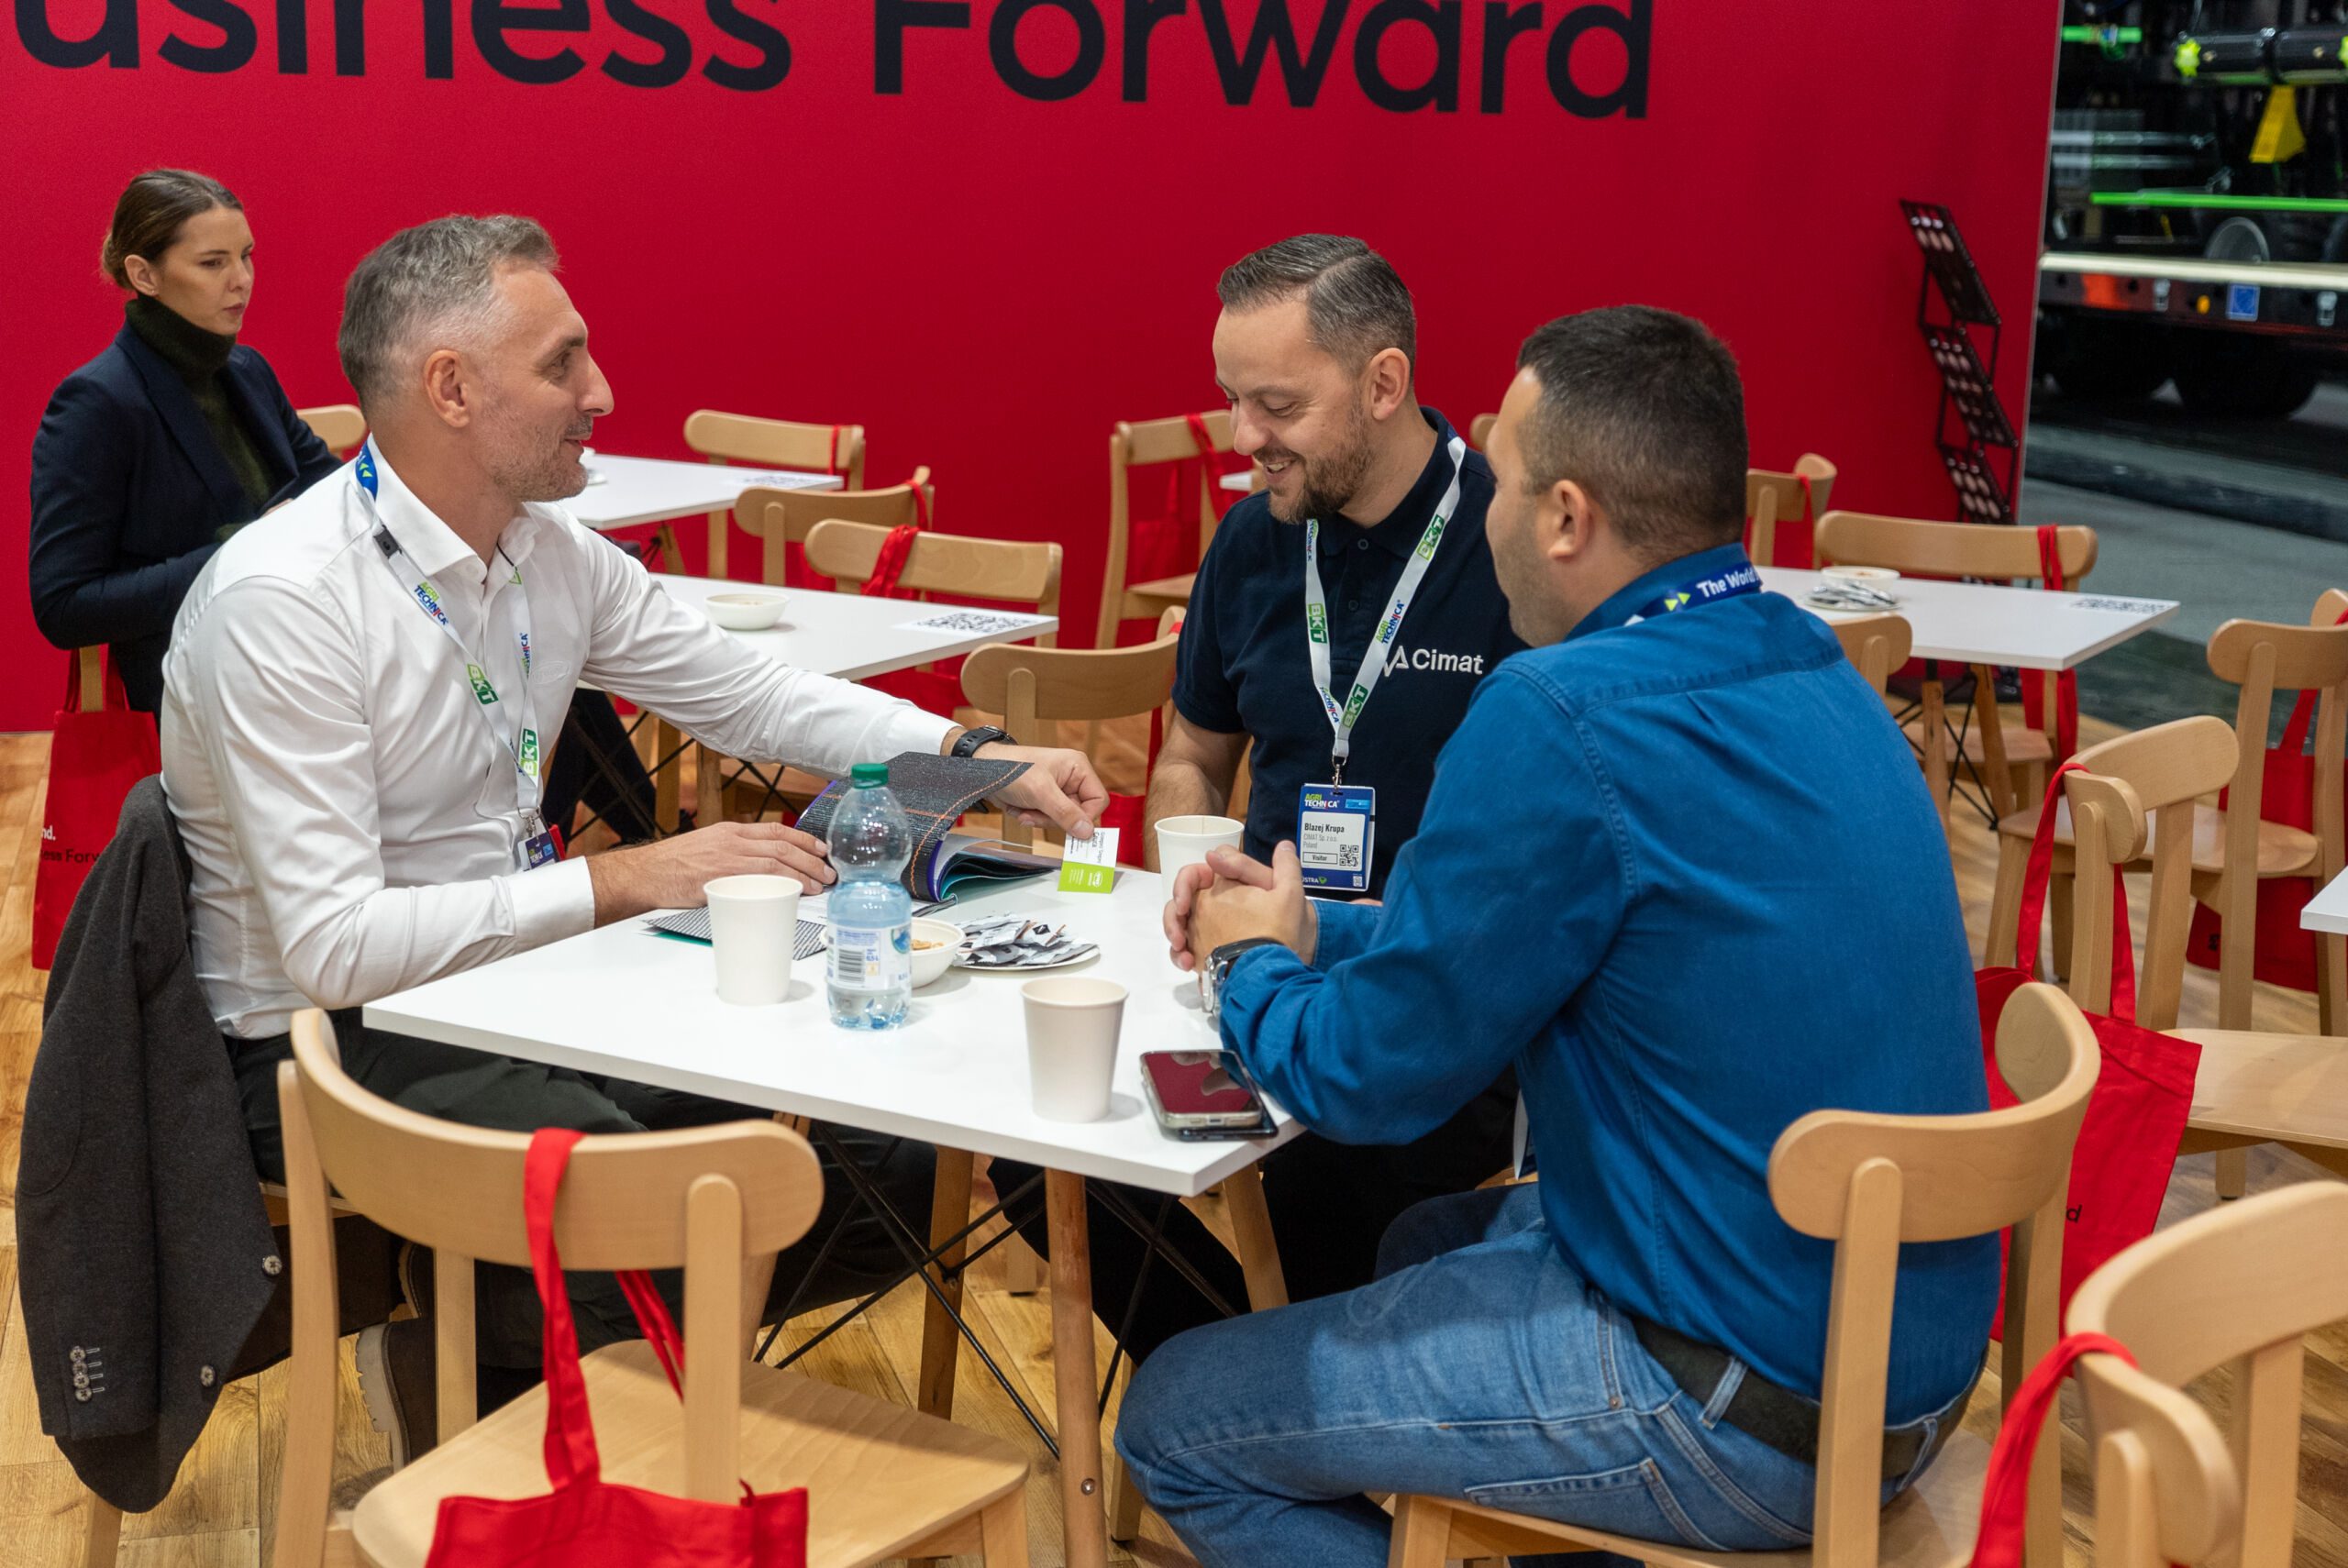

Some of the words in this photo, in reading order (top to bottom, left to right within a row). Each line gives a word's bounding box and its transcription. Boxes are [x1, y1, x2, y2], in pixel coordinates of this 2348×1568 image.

[875, 0, 1653, 119] Forward
[1417, 513, 1445, 561] BKT
[419, 581, 440, 602] AGRI
[1696, 578, 1727, 598] The
[1308, 603, 1327, 644] BKT
[1376, 620, 1389, 643] AGRI
[1412, 648, 1484, 675] Cimat
[467, 663, 499, 705] BKT
[1342, 683, 1368, 728] BKT
[519, 728, 537, 777] BKT
[1303, 841, 1318, 849] Poland
[1304, 823, 1324, 833] Blazej
[1324, 823, 1345, 834] Krupa
